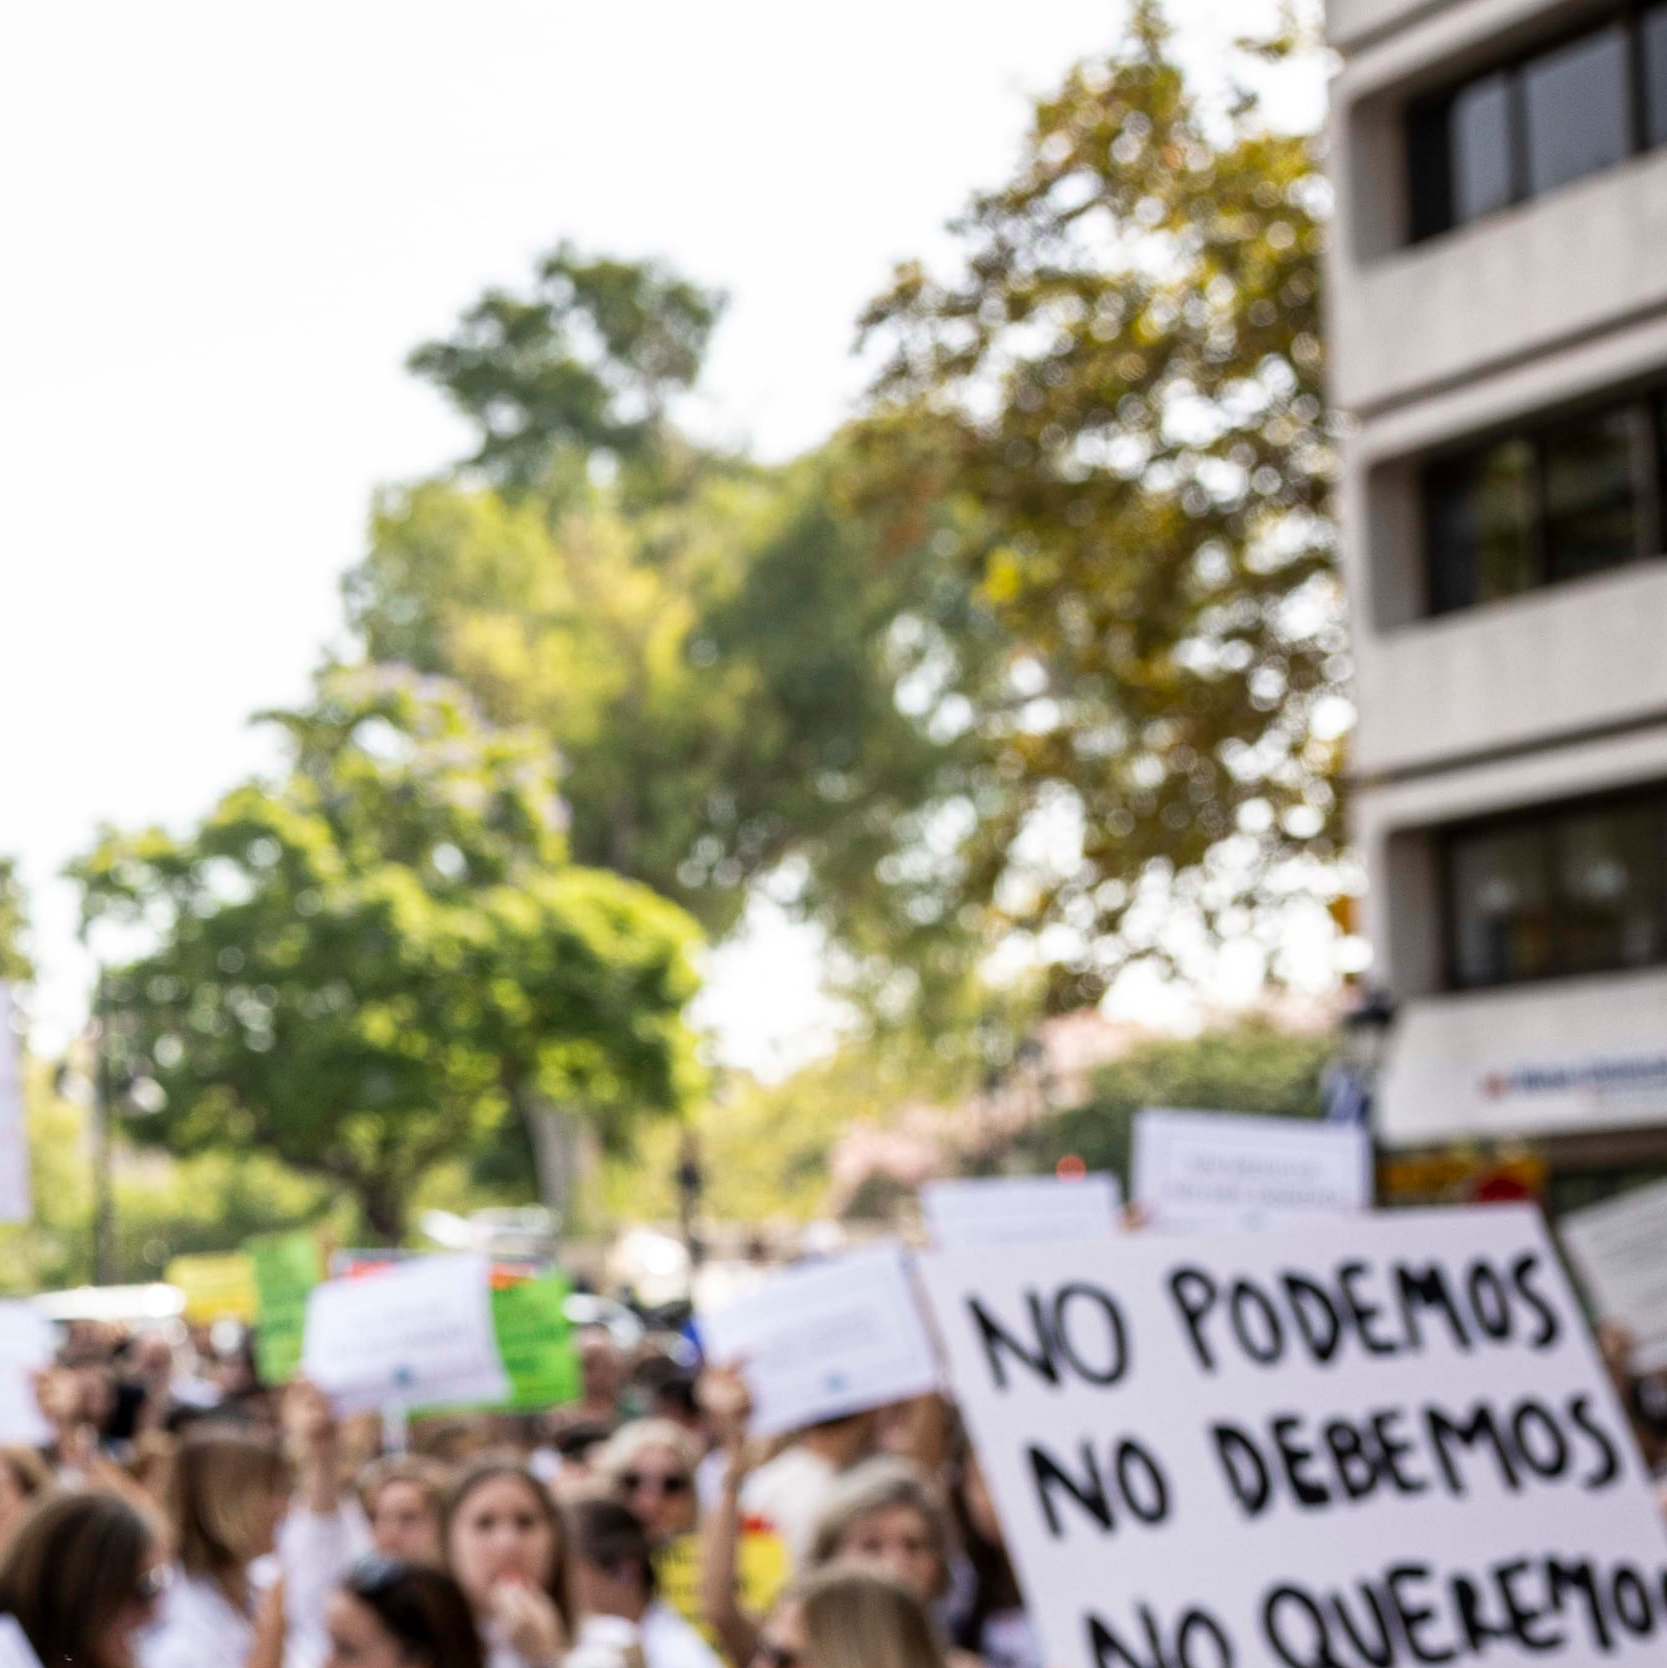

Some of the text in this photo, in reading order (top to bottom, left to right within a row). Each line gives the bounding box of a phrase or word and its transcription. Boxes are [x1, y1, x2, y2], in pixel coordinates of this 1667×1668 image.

[964, 1252, 1562, 1392] NO PODEMOS
[1024, 1394, 1624, 1537] NO DEBEMOS
